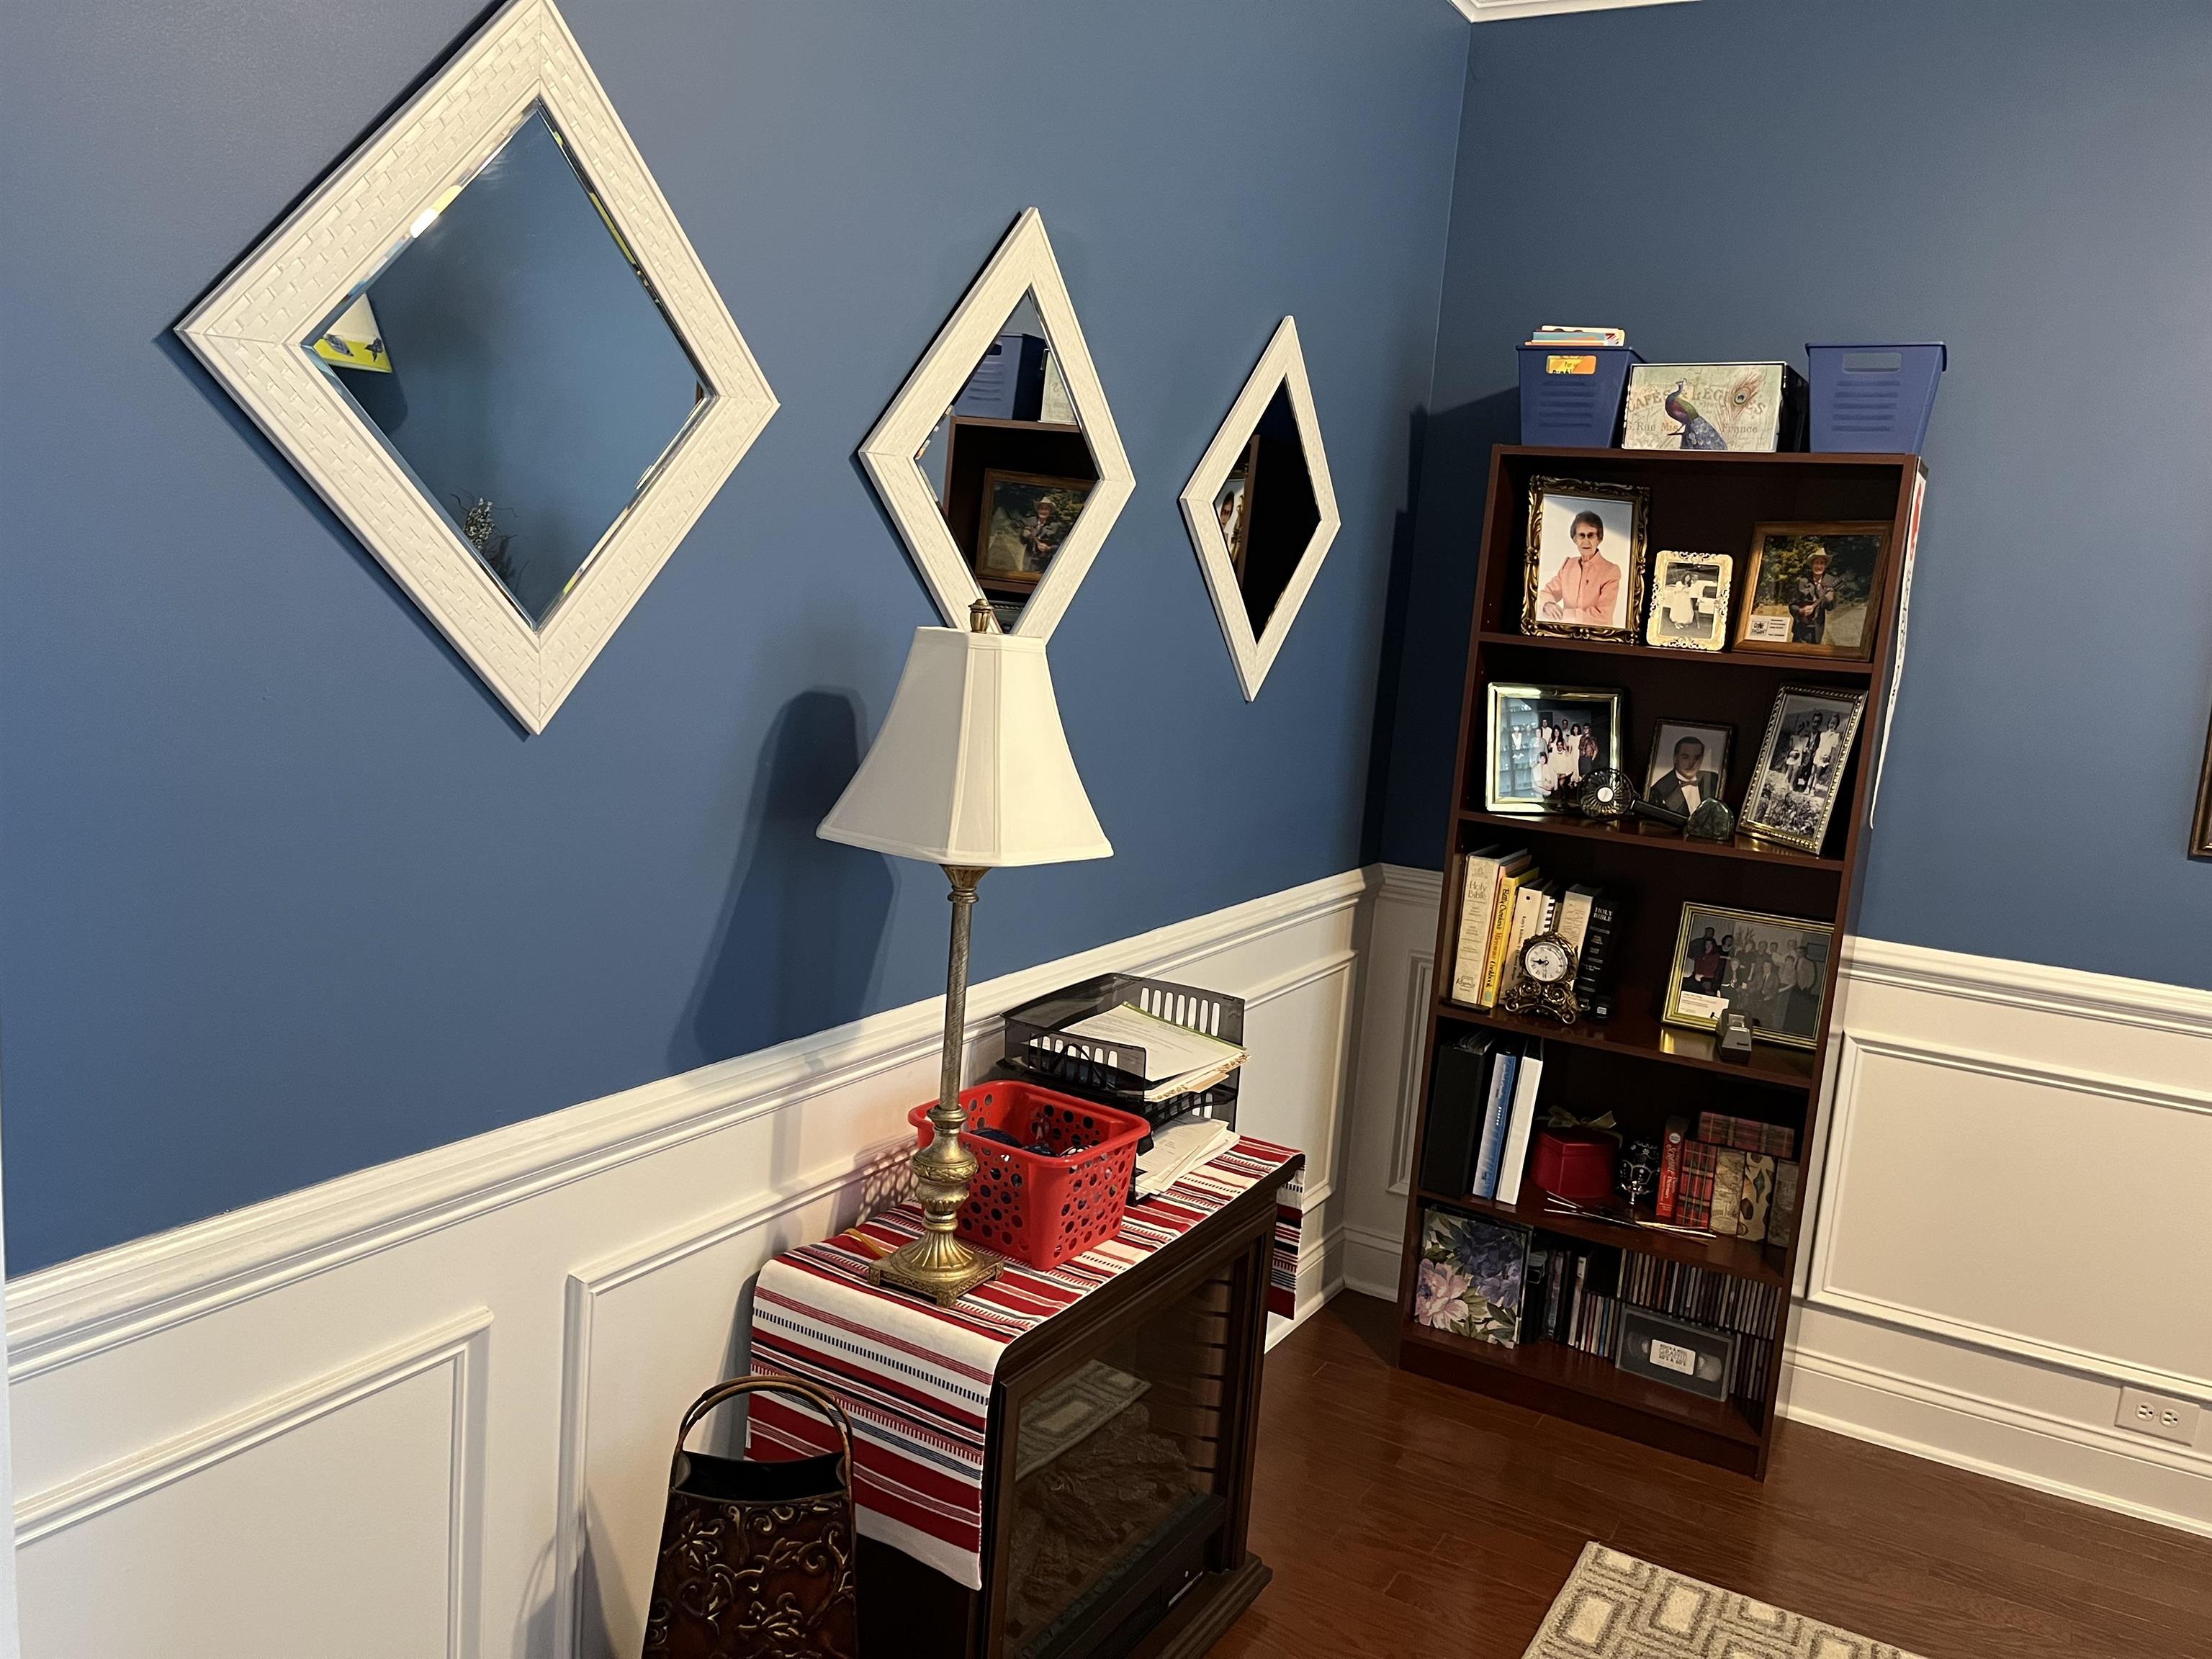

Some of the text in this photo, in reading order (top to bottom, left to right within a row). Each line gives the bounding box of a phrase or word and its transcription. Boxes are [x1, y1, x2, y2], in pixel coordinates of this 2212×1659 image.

[1637, 421, 1655, 431] Rue
[1469, 881, 1487, 893] Holy
[1467, 889, 1487, 899] Bible
[1499, 889, 1509, 906] Betty
[1593, 912, 1613, 922] BIBLE
[1594, 907, 1614, 917] HOLY
[1485, 961, 1496, 988] Cookbook
